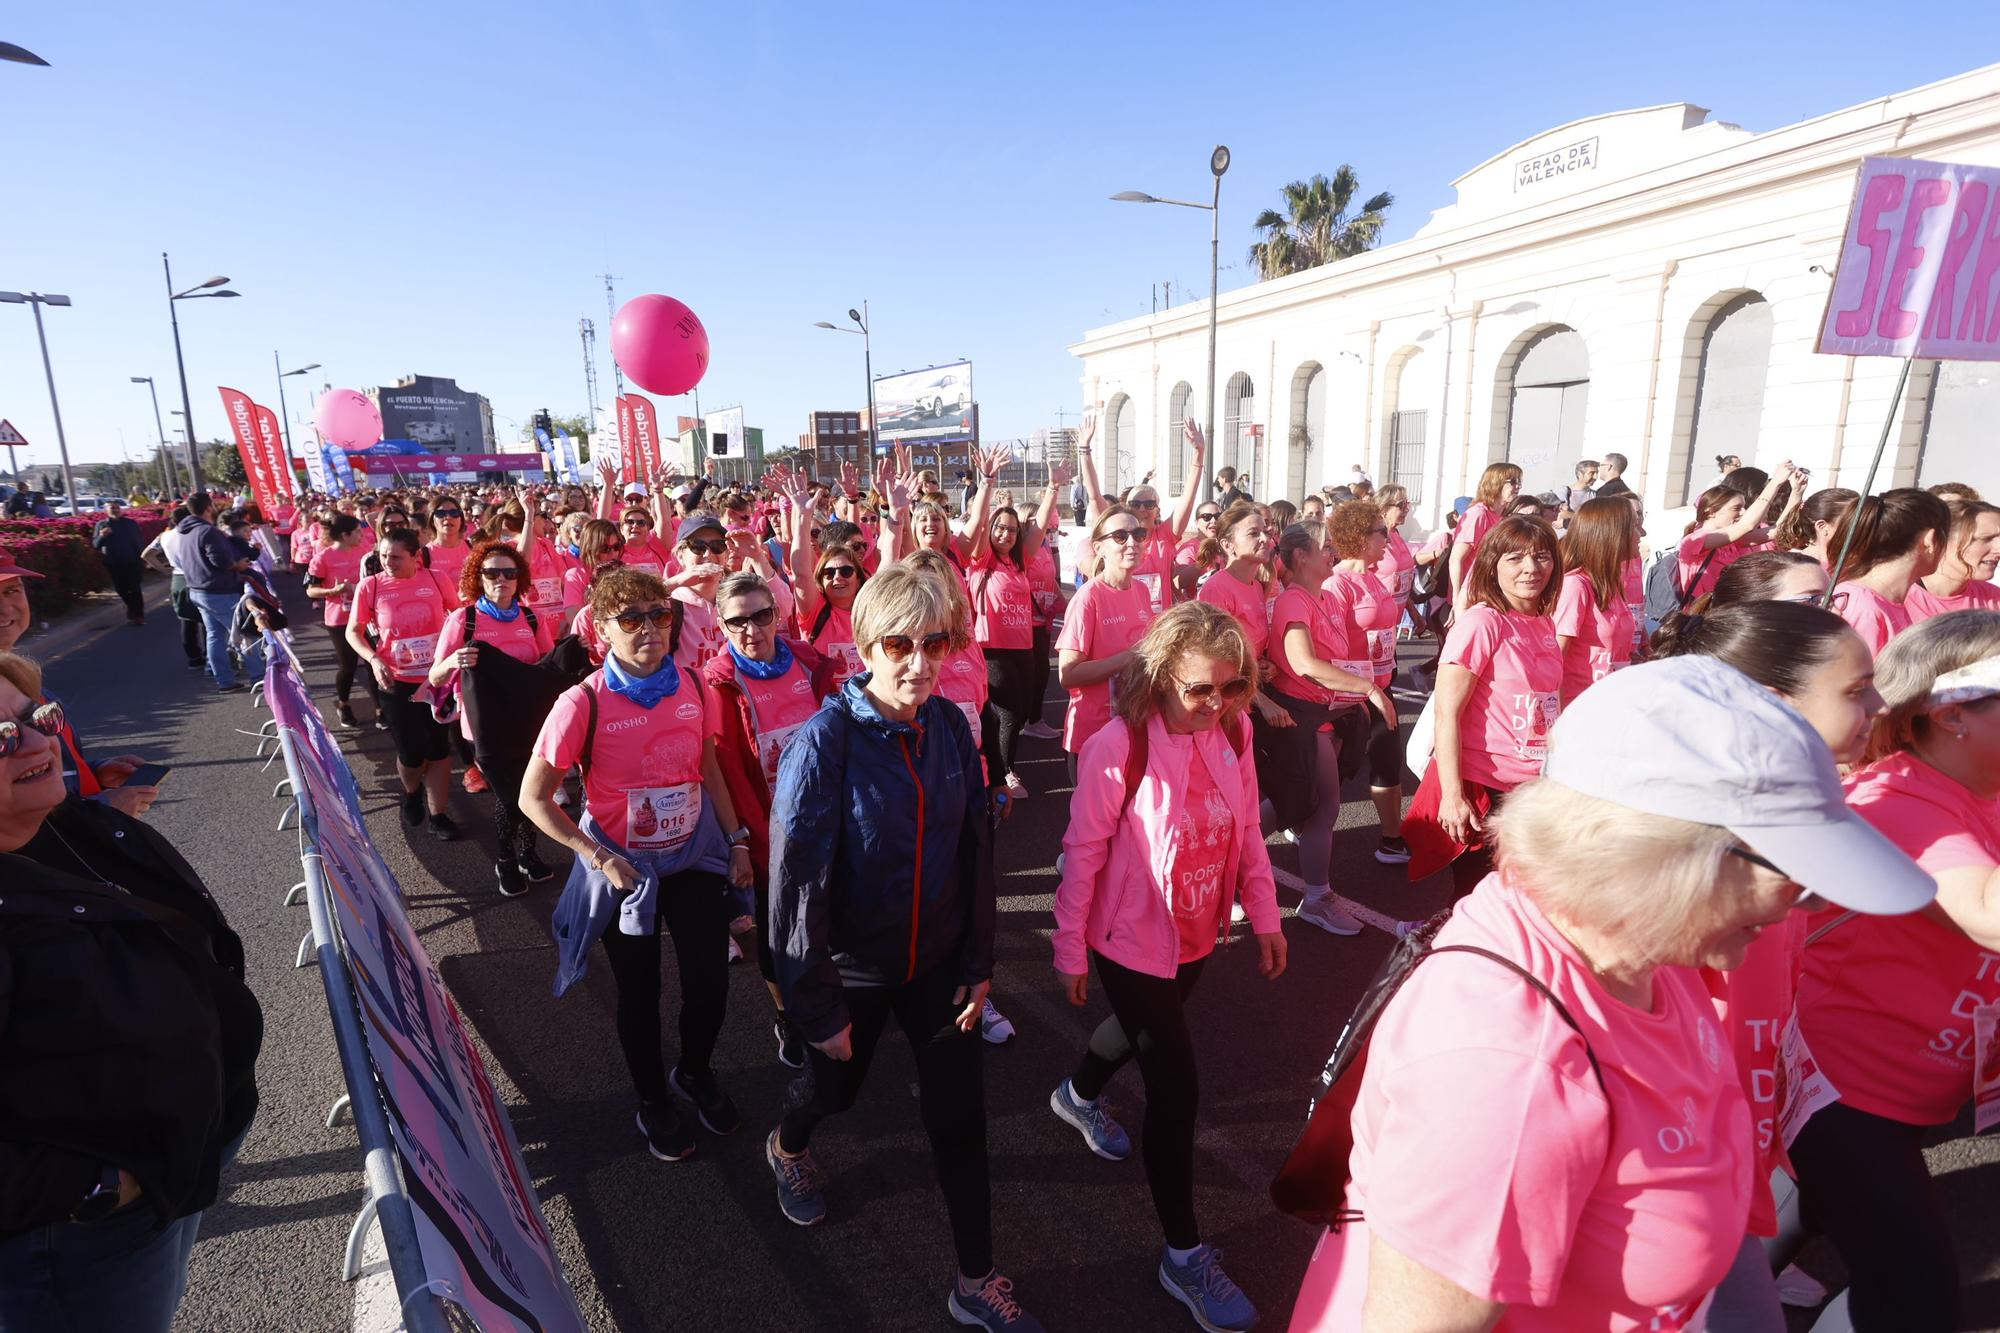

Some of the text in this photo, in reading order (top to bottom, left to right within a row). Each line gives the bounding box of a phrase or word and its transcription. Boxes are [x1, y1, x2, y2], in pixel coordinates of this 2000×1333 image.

[1522, 143, 1590, 174] GRAO DE
[1519, 156, 1591, 187] VALENCIA
[1835, 173, 2000, 342] SERR
[395, 396, 422, 404] PUERTO
[606, 715, 648, 733] OYSHO
[660, 813, 685, 829] 016
[1183, 861, 1226, 886] DORS
